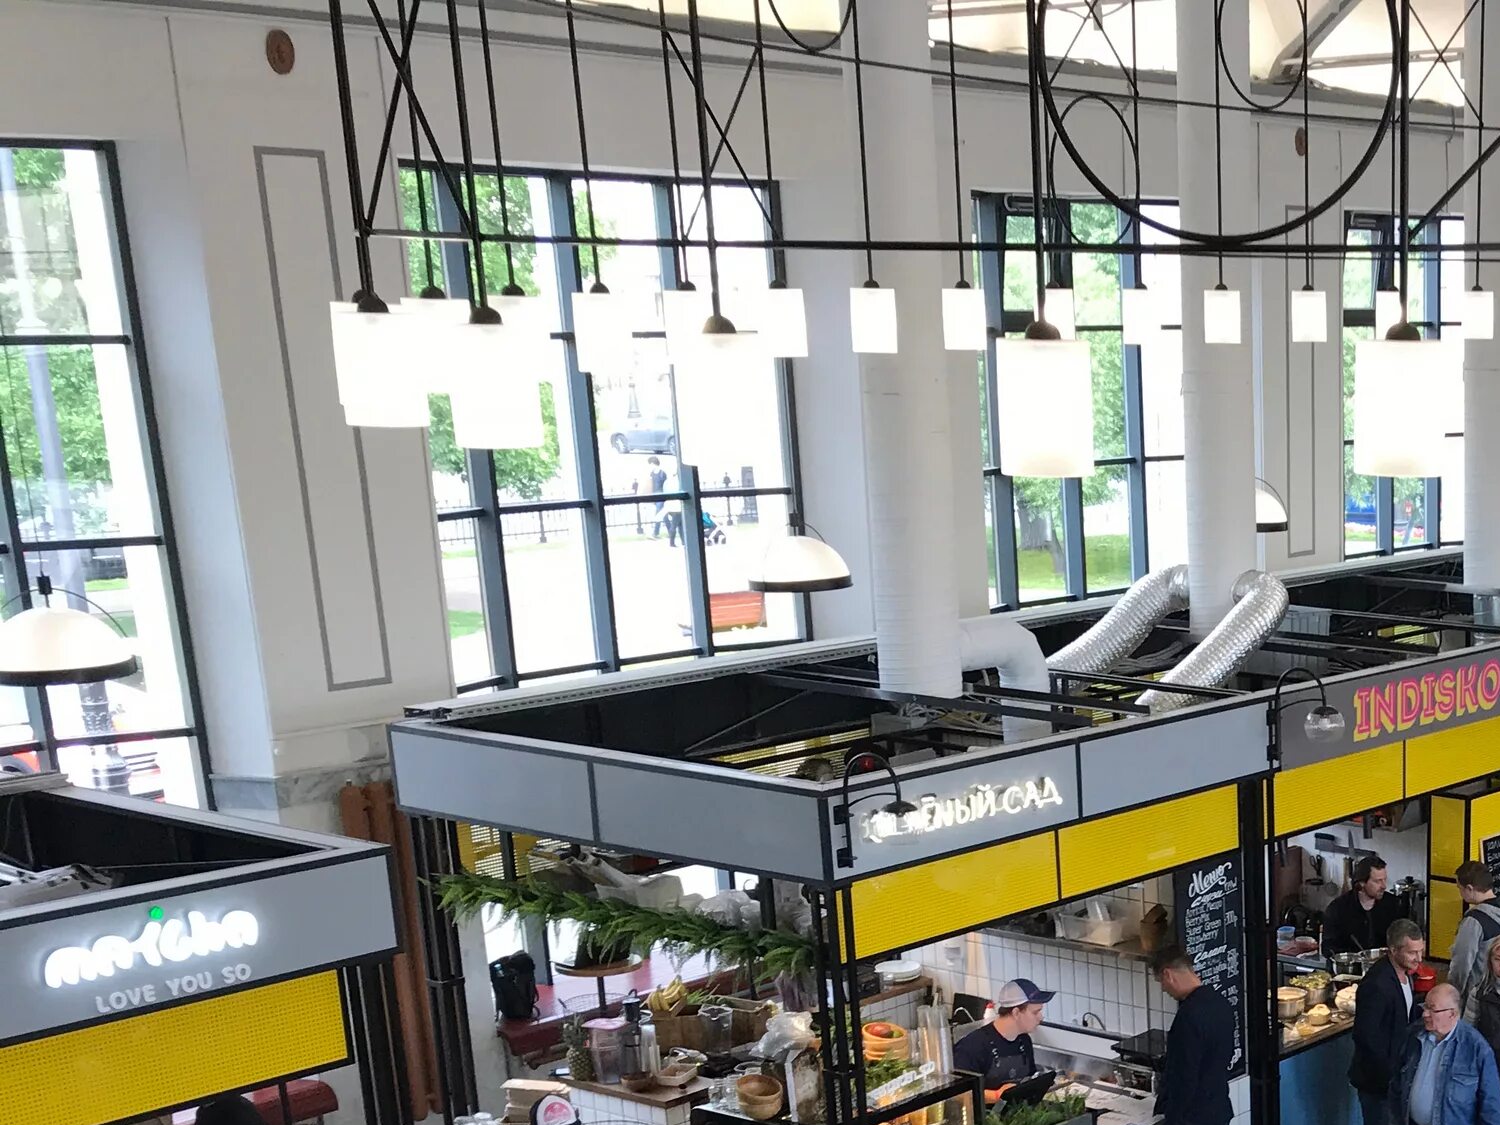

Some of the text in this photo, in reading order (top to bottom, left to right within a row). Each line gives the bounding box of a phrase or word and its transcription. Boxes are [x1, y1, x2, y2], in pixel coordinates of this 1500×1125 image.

[1003, 777, 1064, 816] САД
[95, 962, 252, 1013] LOVE YOU SO
